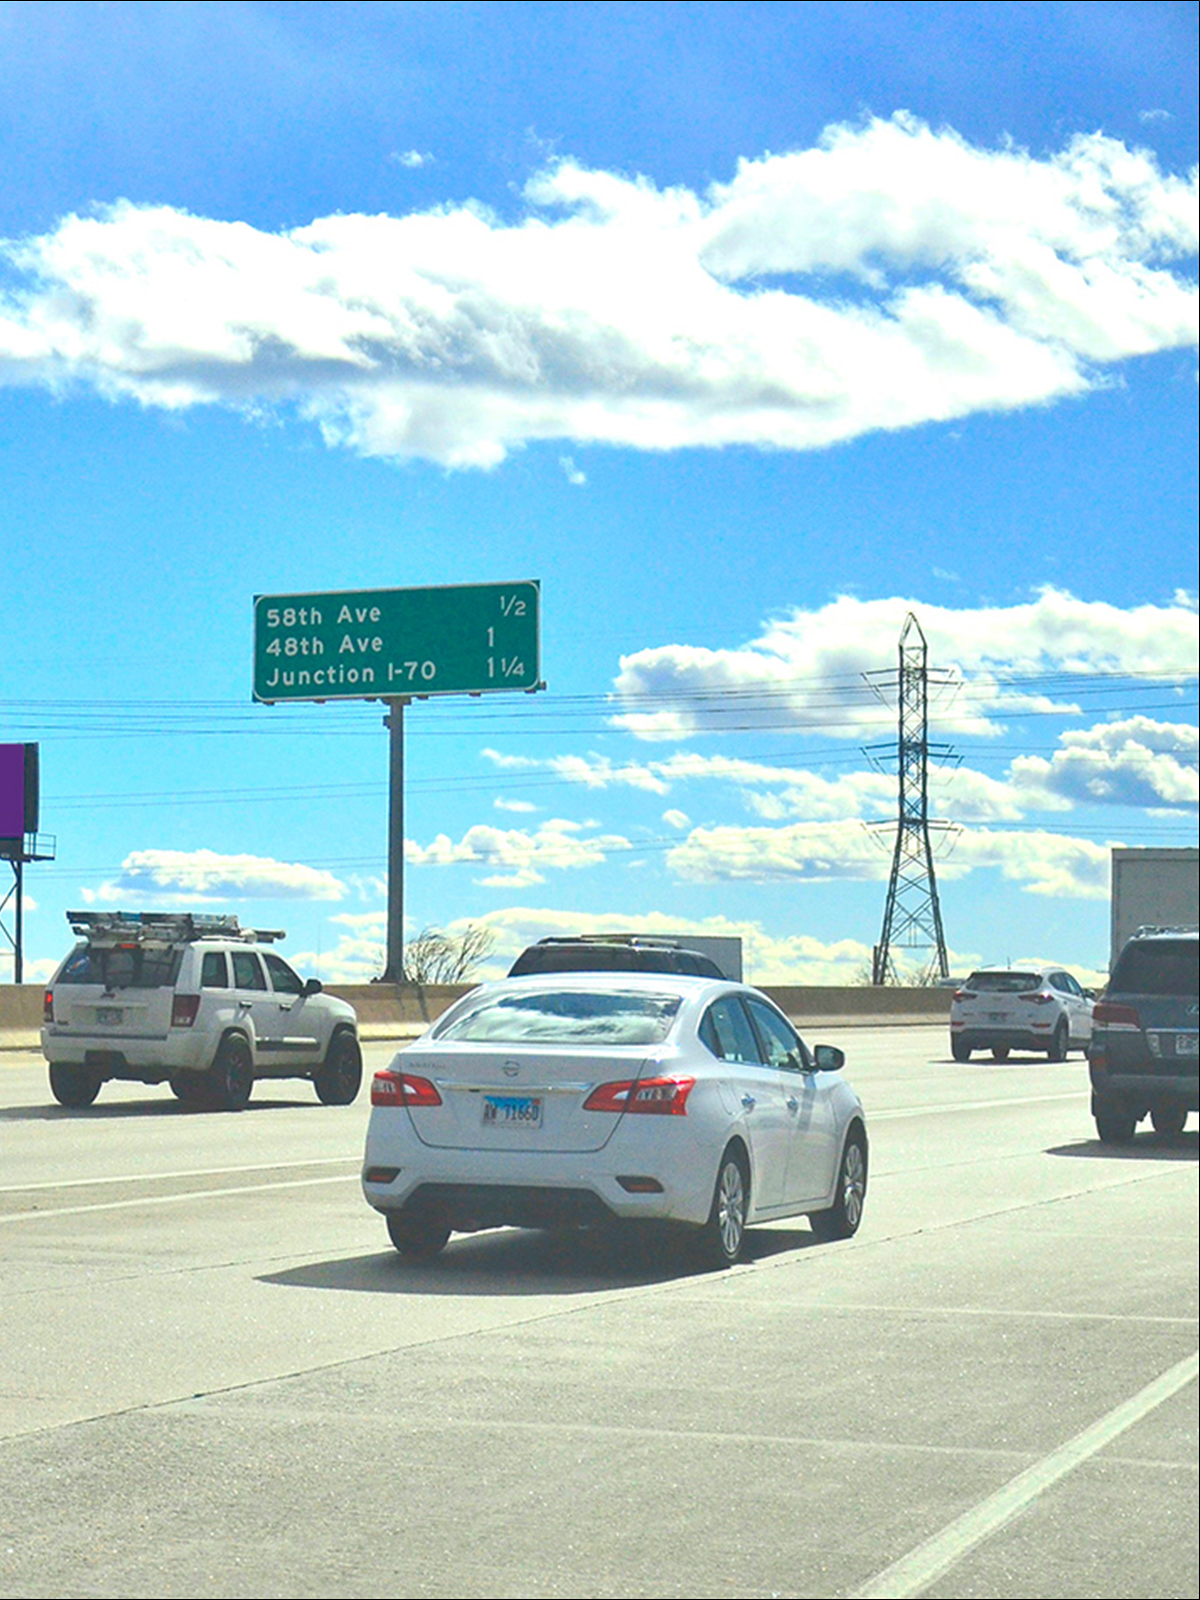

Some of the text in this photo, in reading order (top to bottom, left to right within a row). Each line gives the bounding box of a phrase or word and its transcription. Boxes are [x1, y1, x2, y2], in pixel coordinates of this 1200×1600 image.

[266, 607, 323, 628] 58th
[337, 604, 382, 624] Ave
[266, 626, 495, 657] 48th Ave 1
[266, 663, 375, 688] Junction
[388, 660, 437, 682] I-70
